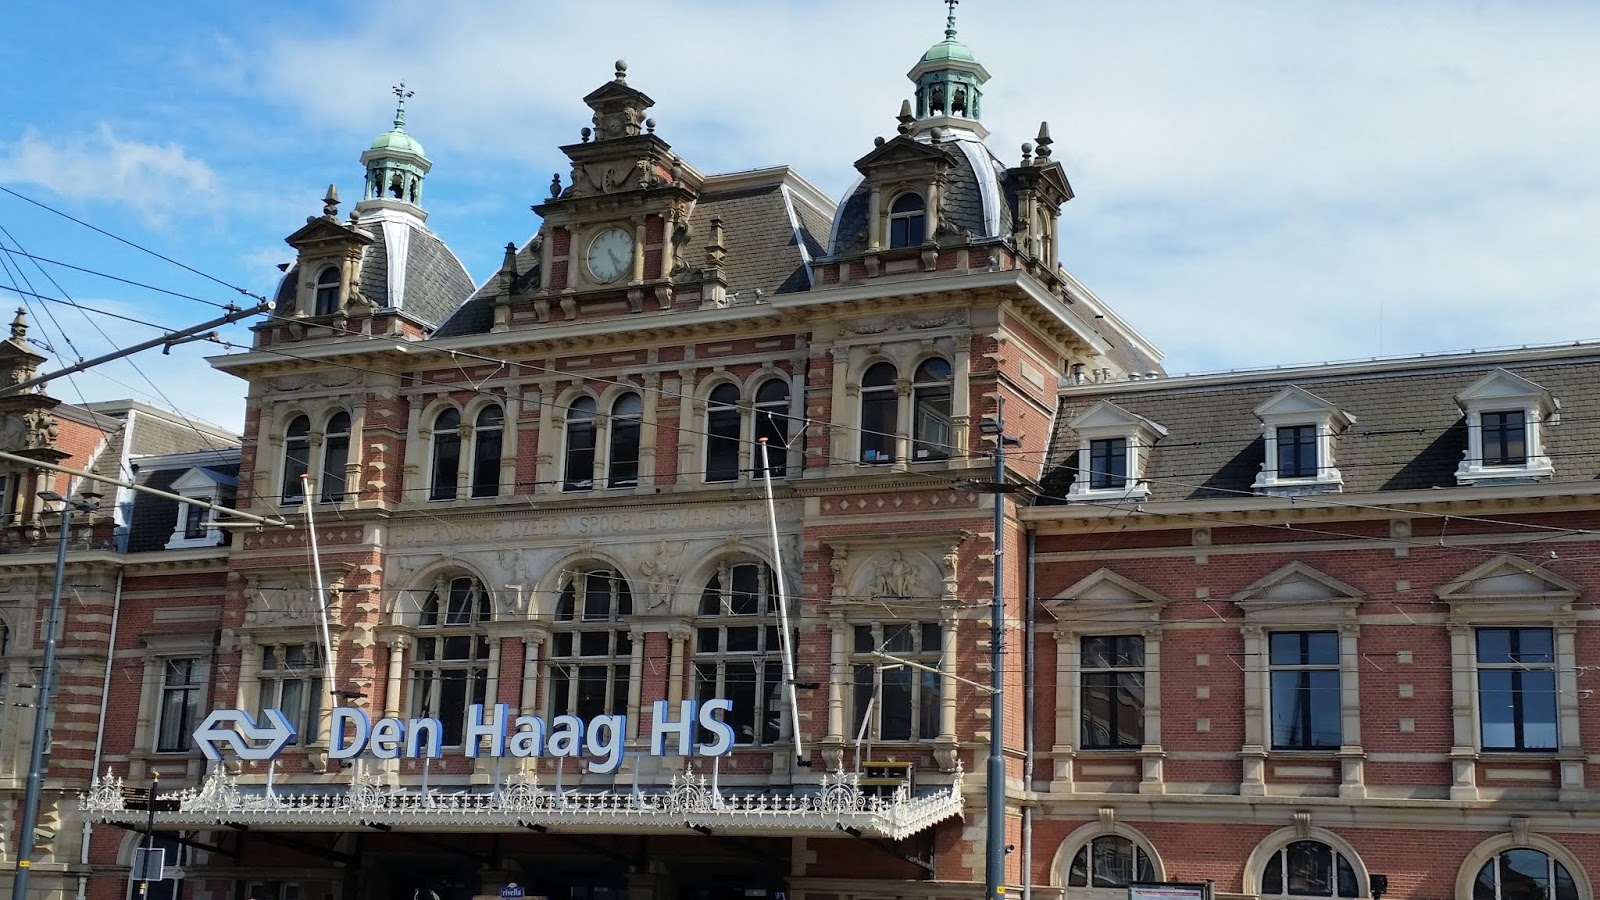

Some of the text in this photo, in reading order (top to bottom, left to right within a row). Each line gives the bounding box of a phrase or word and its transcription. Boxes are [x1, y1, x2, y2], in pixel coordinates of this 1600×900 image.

[393, 520, 504, 544] HOLLANDSCHE
[328, 698, 735, 774] Den Haag HS
